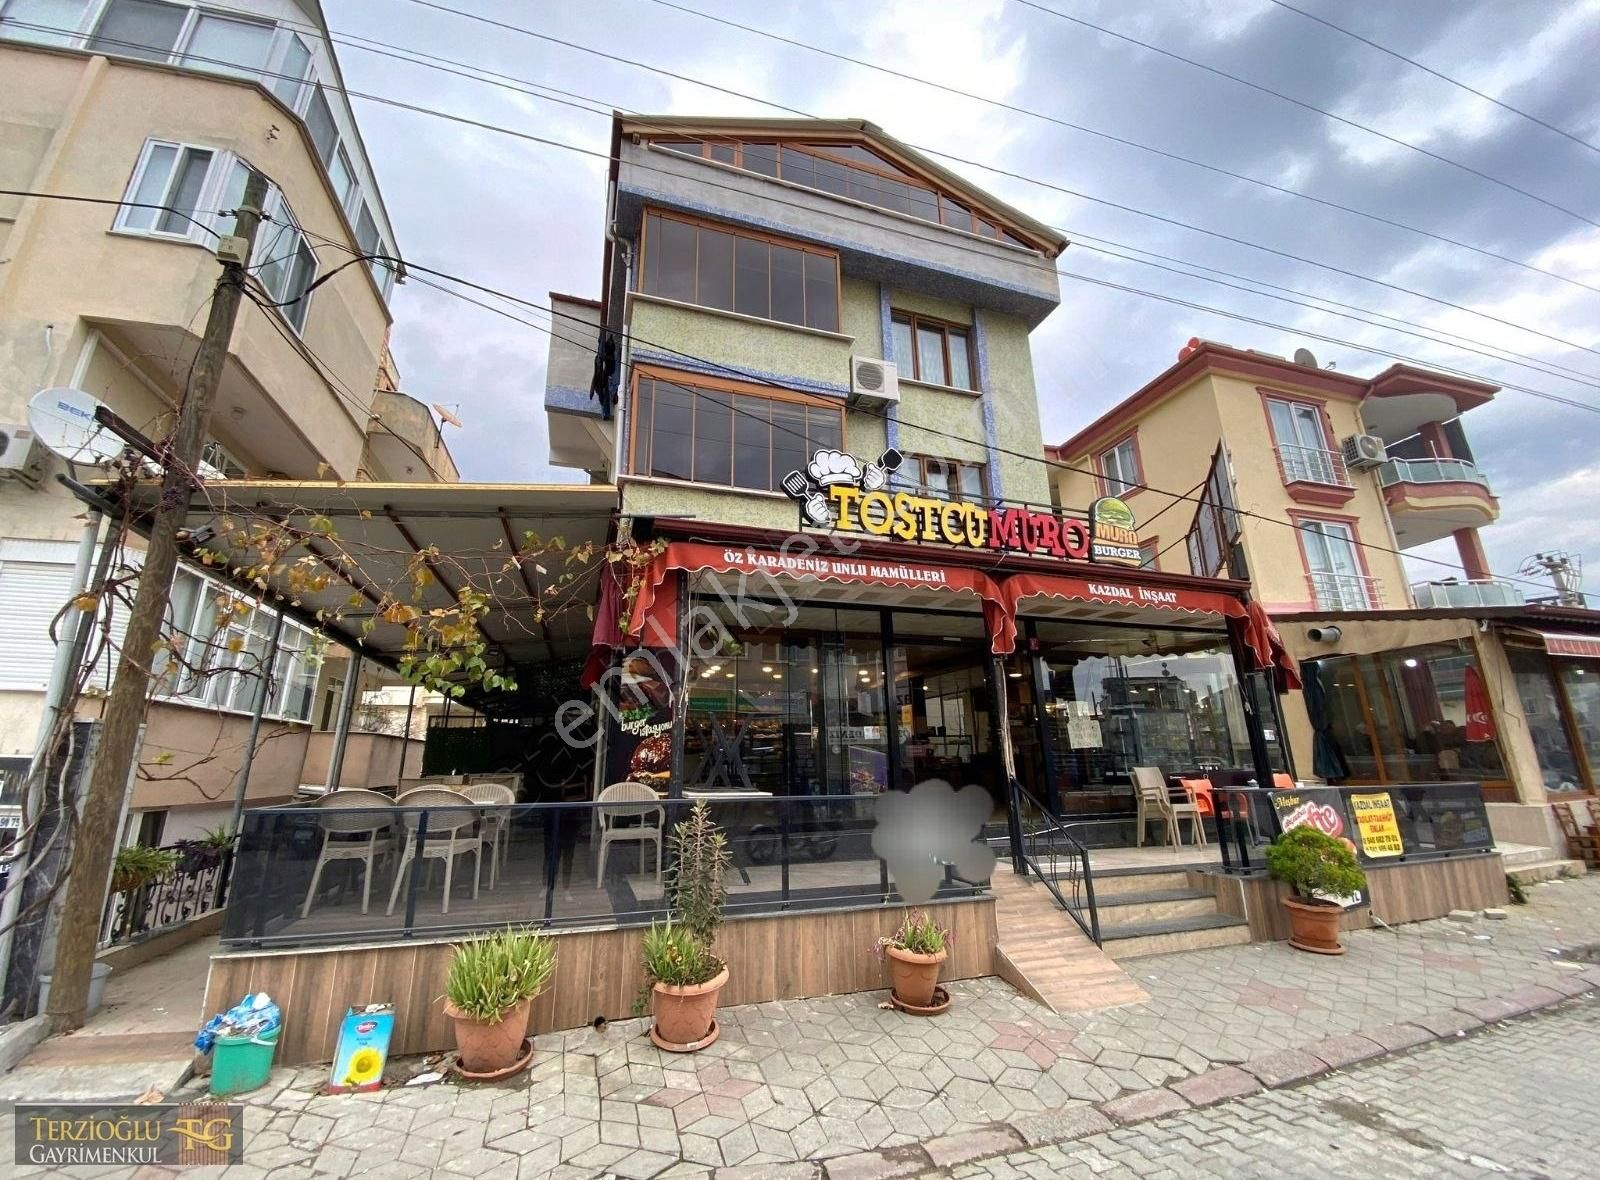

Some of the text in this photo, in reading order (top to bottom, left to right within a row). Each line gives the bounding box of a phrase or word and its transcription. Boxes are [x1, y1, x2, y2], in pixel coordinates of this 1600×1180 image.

[57, 401, 91, 421] BEK
[830, 484, 987, 548] TOSTCU
[1096, 522, 1138, 545] MURO
[1093, 545, 1141, 560] BURGER
[723, 549, 945, 583] ÖZ KARADENİZ UNLU MAMÜLLERİ
[1088, 583, 1177, 604] KAZDAL İNŞAAT
[621, 718, 647, 735] burger
